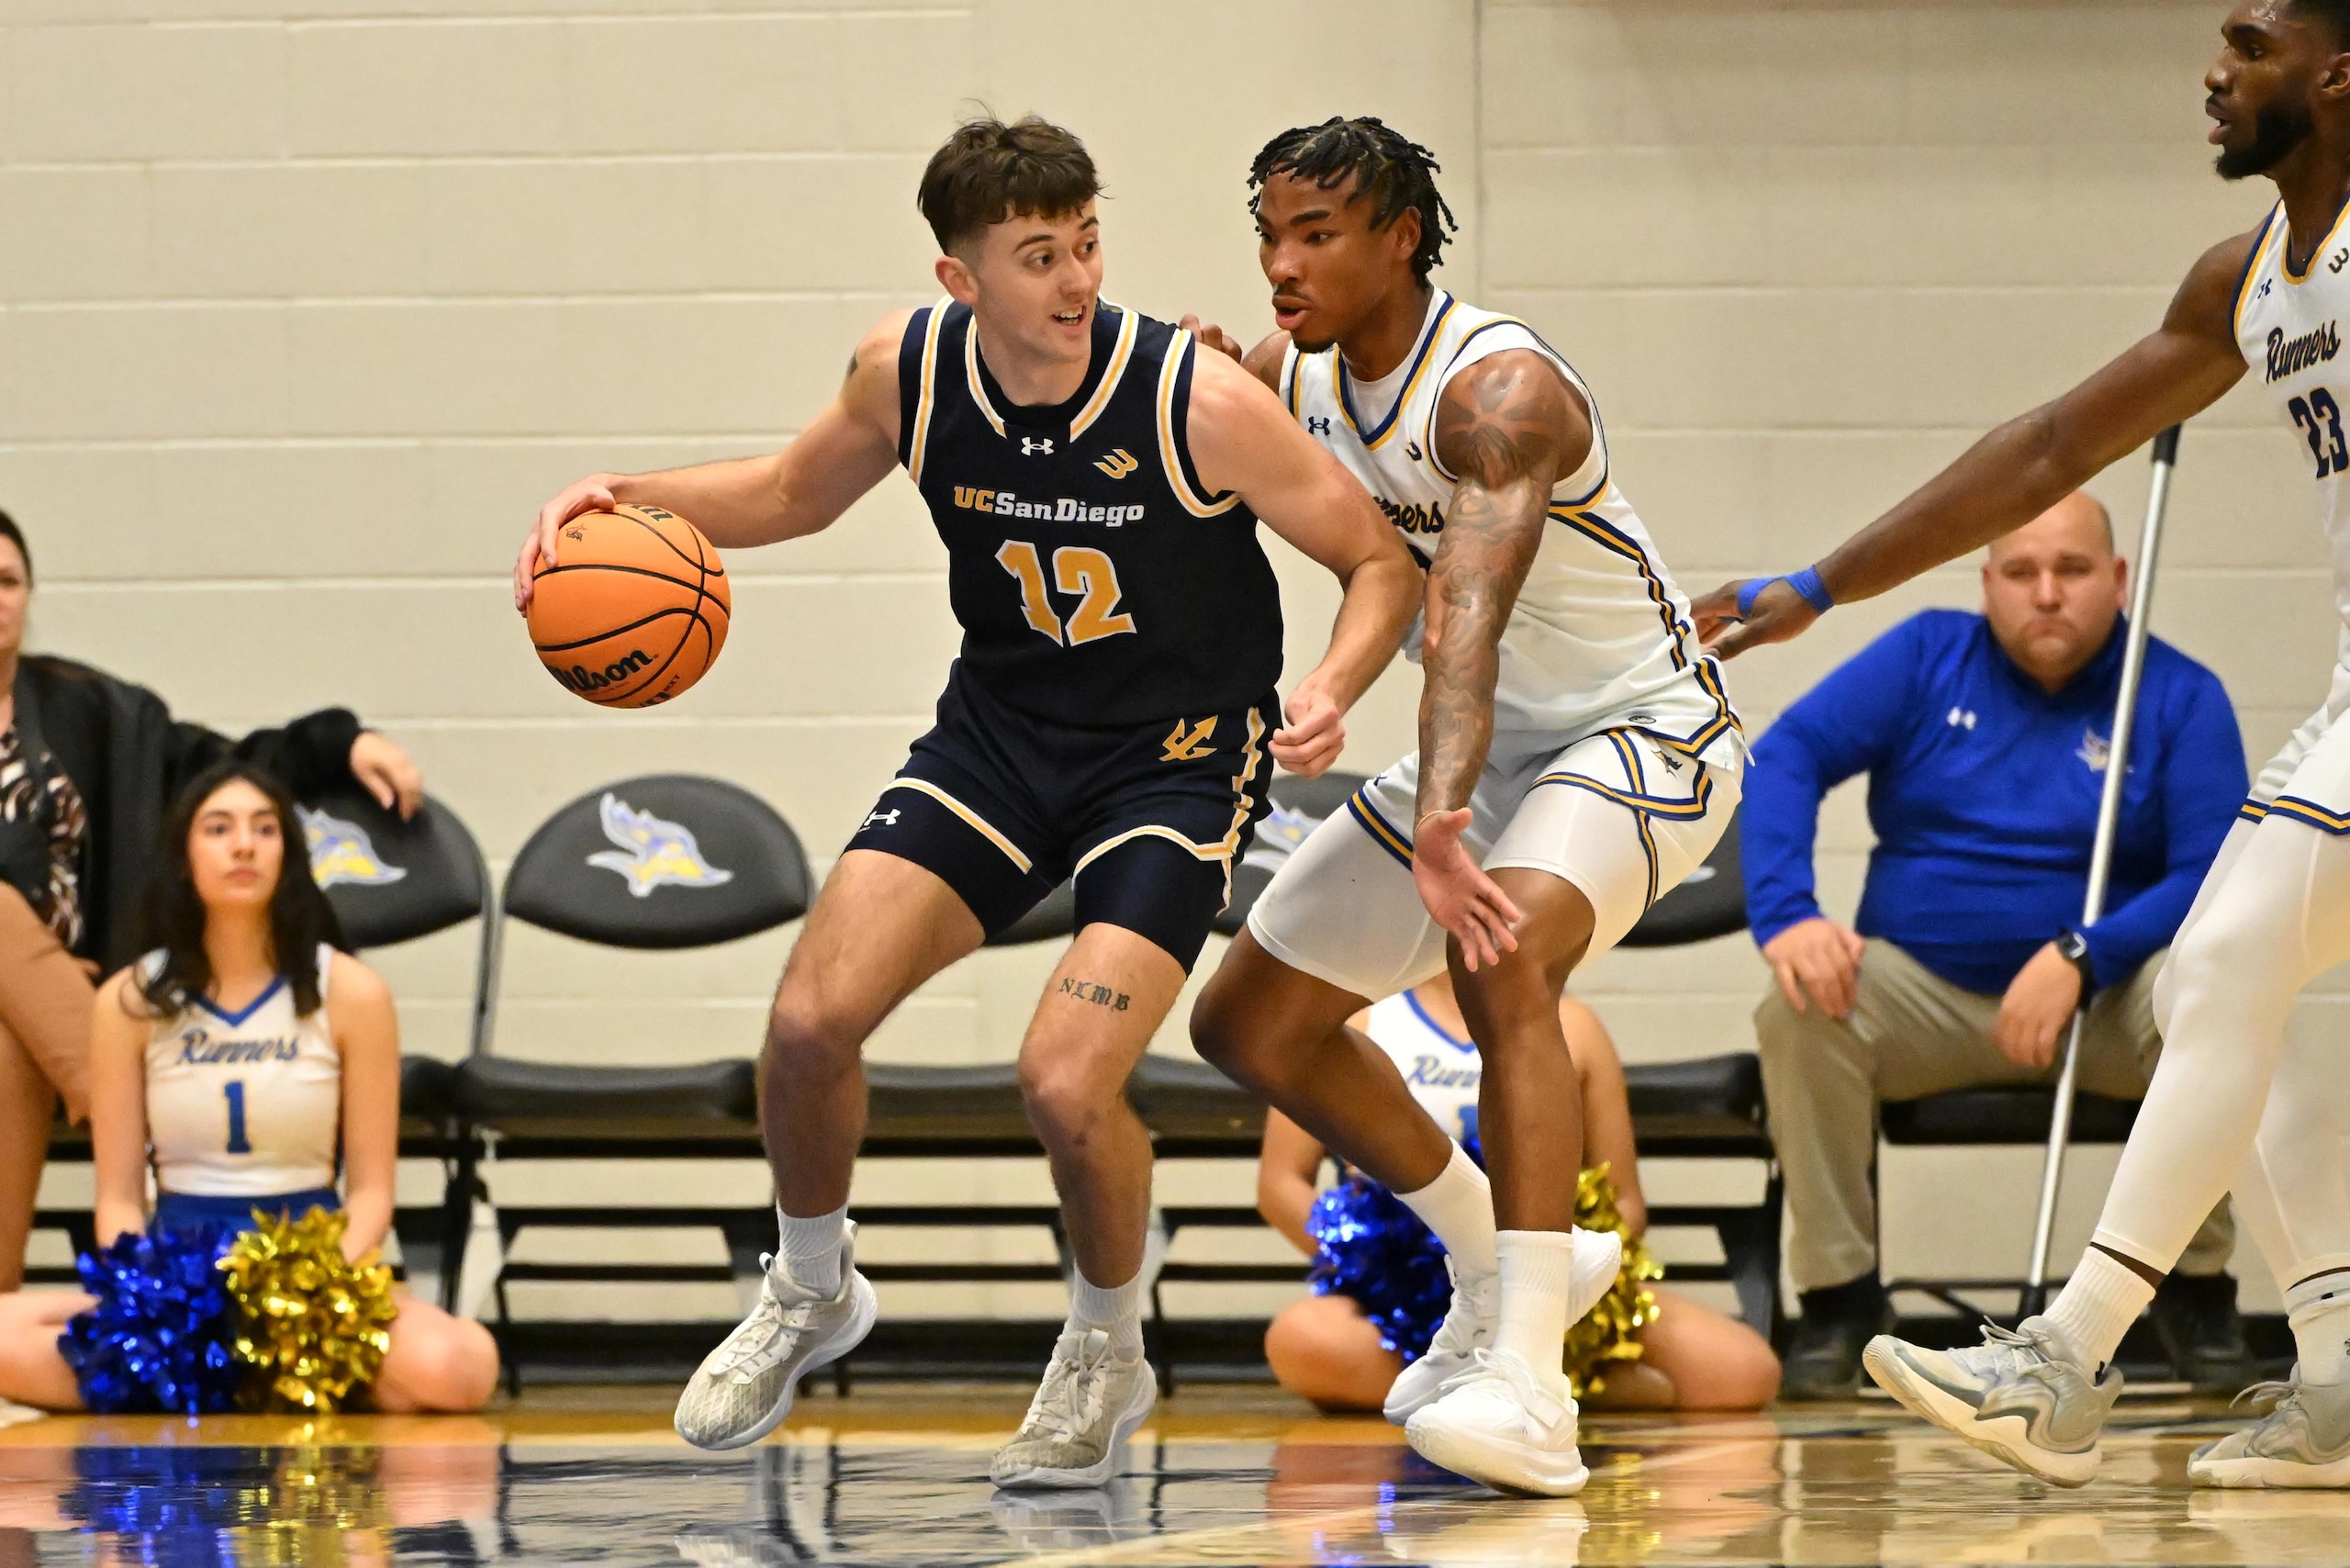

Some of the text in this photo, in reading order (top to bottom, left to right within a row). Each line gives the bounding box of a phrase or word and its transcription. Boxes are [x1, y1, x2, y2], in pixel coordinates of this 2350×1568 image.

[2266, 319, 2341, 385] Runners
[2288, 386, 2349, 479] 23
[994, 539, 1138, 648] 12
[176, 1027, 299, 1065] Runners
[1406, 1055, 1483, 1088] Runn
[224, 1081, 252, 1154] 1
